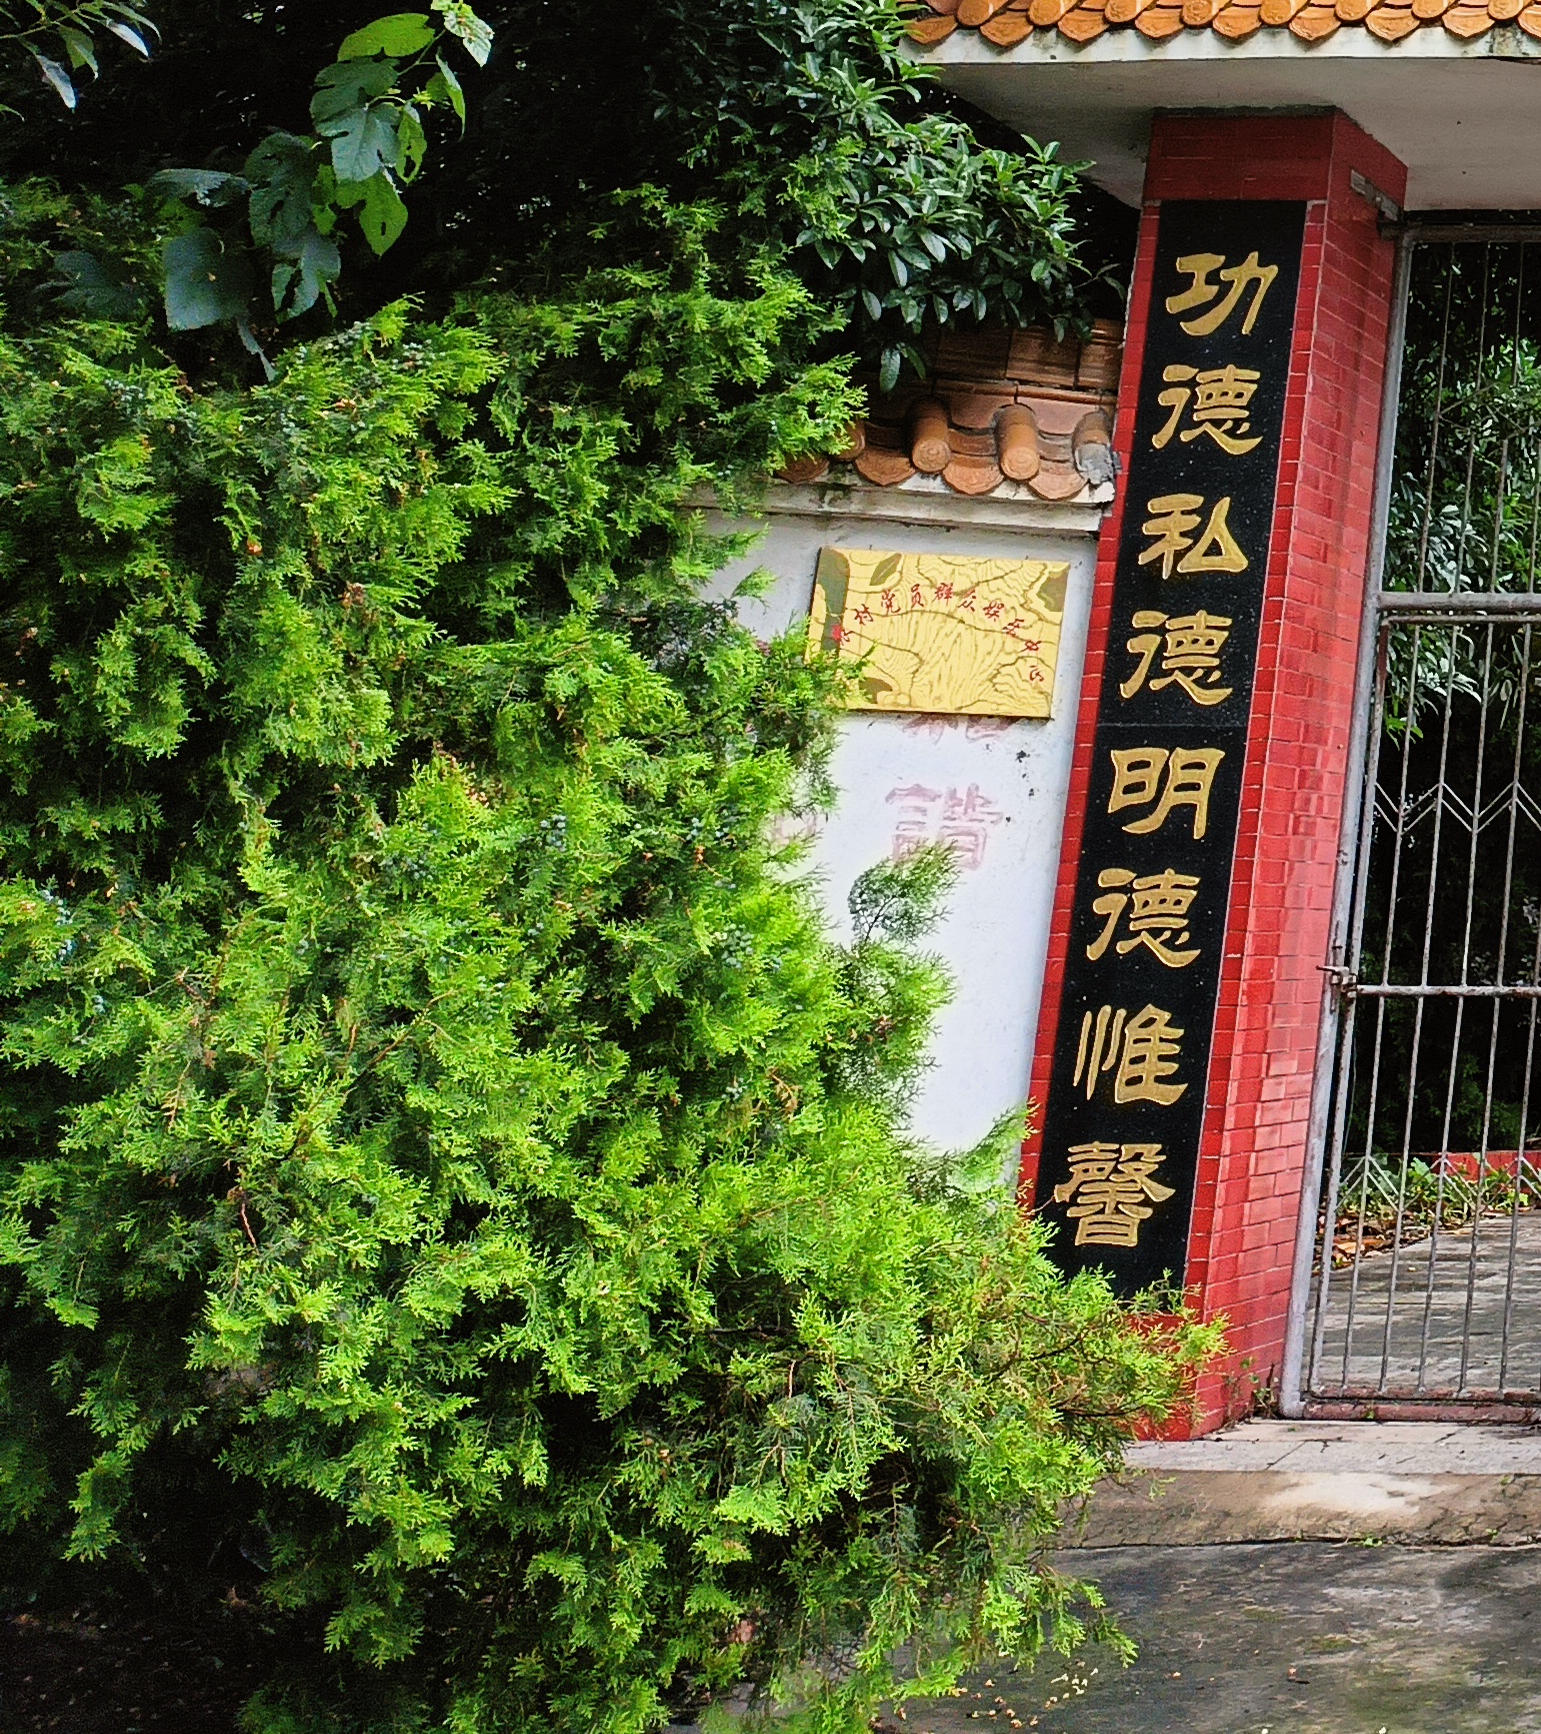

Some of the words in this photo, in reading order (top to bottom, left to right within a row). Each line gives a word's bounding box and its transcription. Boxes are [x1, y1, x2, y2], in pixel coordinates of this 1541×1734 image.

[1054, 251, 1278, 1248] 功德私德明德惟馨
